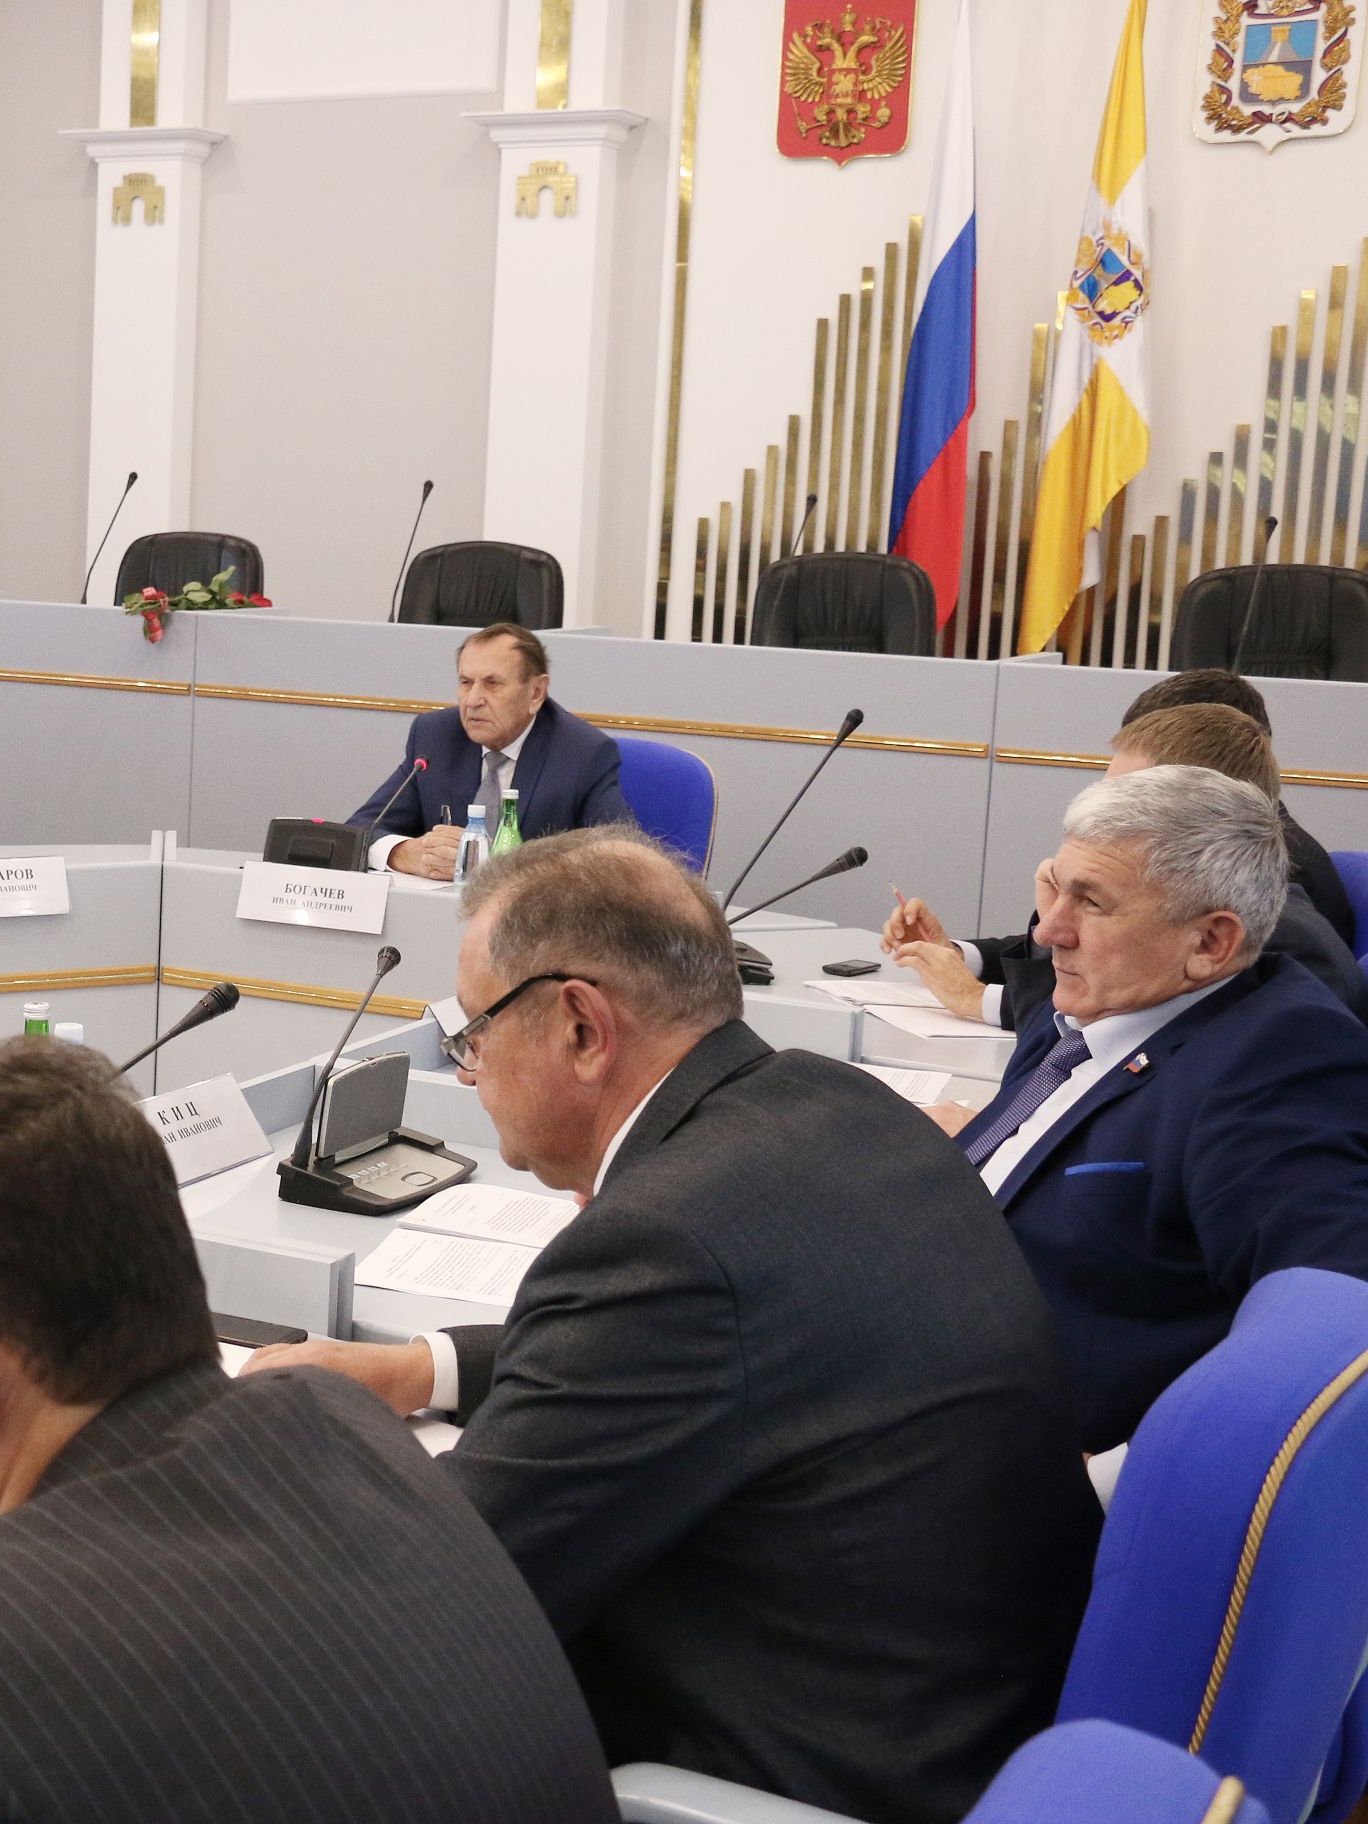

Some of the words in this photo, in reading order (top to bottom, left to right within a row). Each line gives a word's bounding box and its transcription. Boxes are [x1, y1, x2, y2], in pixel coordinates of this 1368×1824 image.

[284, 883, 345, 900] БОГАЧЕВ
[272, 896, 296, 906] ИВАН
[301, 900, 353, 913] АНДРЕЕВИЧ
[157, 1101, 200, 1126] КИЦ
[177, 1116, 224, 1140] ИВАНОВИЧ
